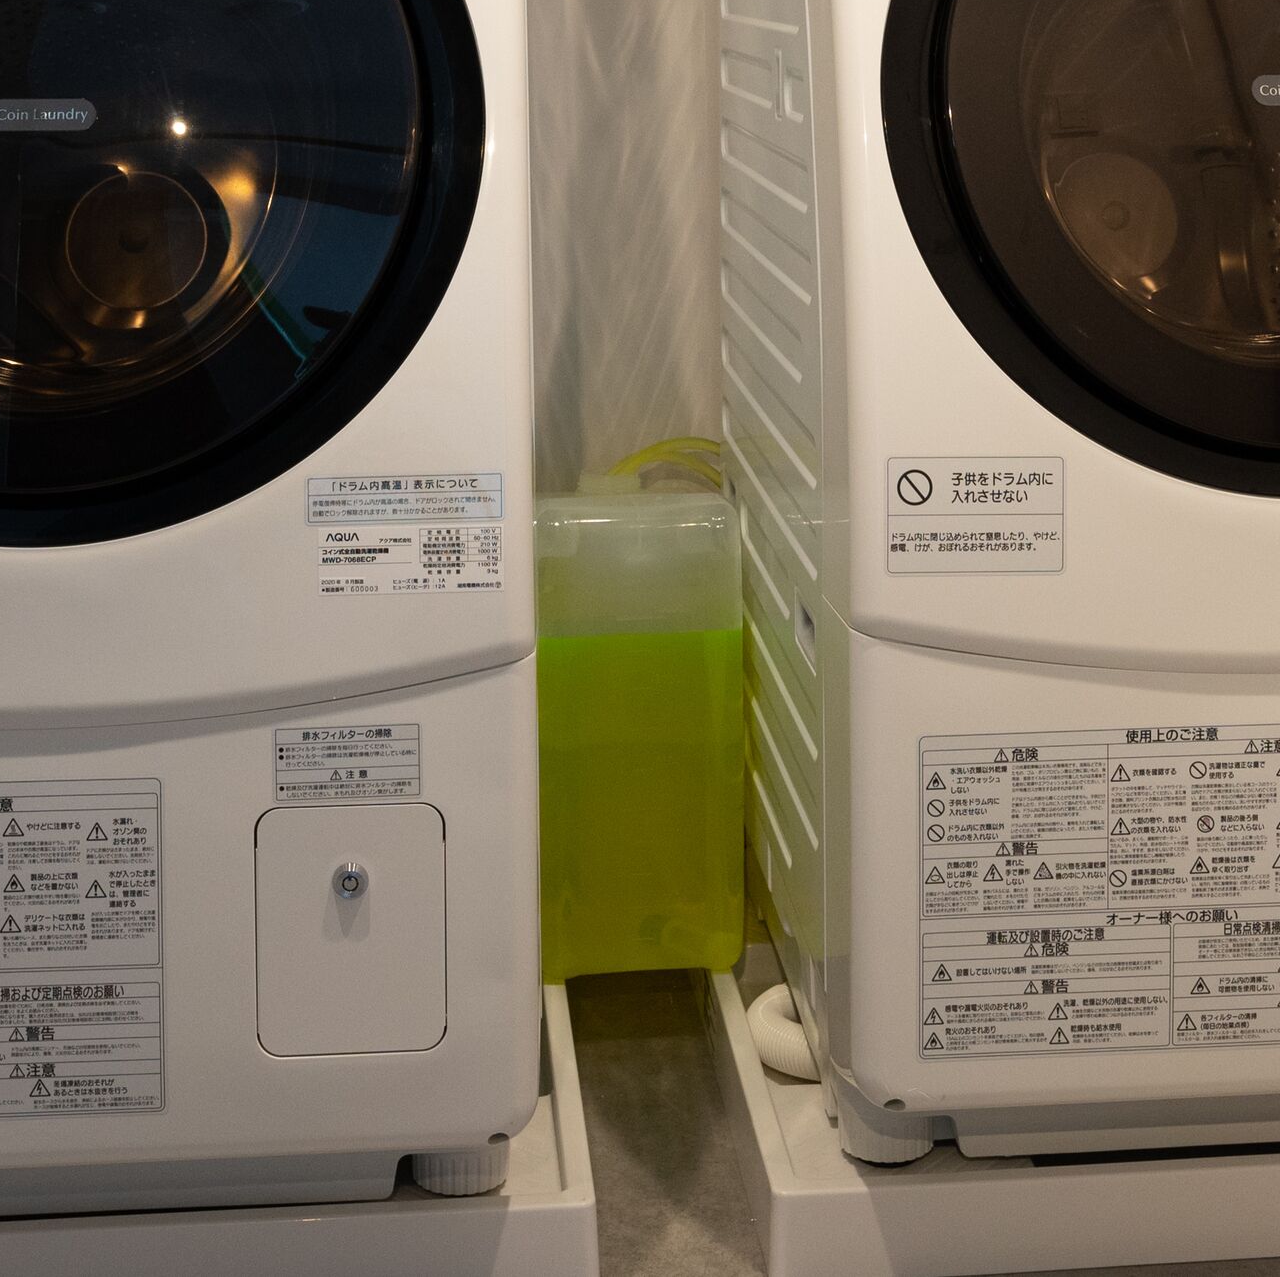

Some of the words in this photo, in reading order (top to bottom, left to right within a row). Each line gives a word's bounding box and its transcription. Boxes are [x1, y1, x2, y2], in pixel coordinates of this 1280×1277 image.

[33, 109, 88, 122] Laundry
[332, 479, 478, 491] 「ドラム内高温」表示について
[951, 473, 1053, 486] 子供をドラム内に
[951, 490, 1028, 503] 入れさせない
[326, 533, 359, 542] AQUA
[302, 729, 392, 741] 排水フィルターの掃除
[1126, 728, 1218, 743] 使用上のご注意
[1012, 748, 1038, 761] 危険
[1107, 910, 1238, 925] オーナー様へのお願い
[987, 928, 1104, 944] 運転及び設置時のご注意
[1042, 943, 1069, 956] 危険
[1042, 980, 1068, 993] 警告
[26, 1027, 55, 1041] 警告
[26, 1064, 56, 1078] 注意
